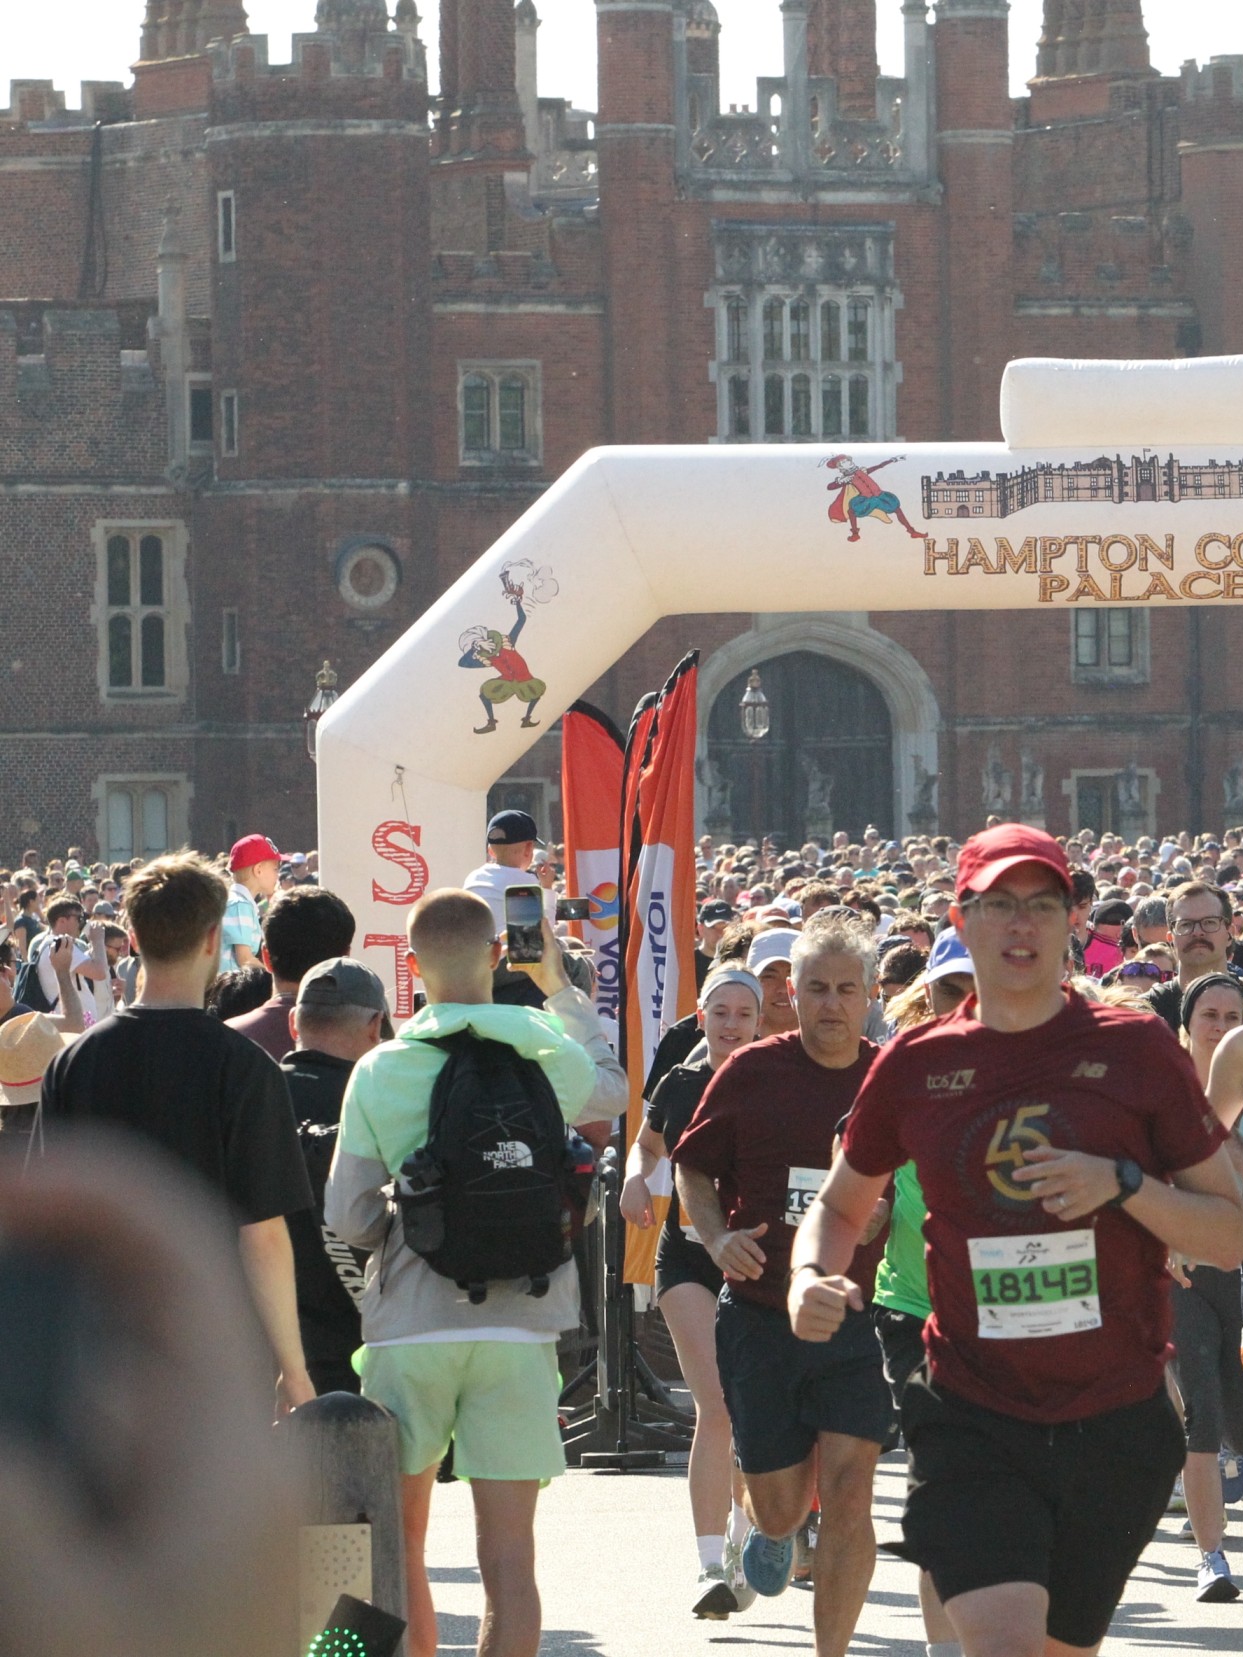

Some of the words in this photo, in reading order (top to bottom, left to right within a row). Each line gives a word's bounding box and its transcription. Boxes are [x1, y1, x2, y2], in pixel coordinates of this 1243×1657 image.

[923, 533, 1175, 576] HAMPTON
[497, 1141, 516, 1151] THE
[980, 1264, 1092, 1304] 18143
